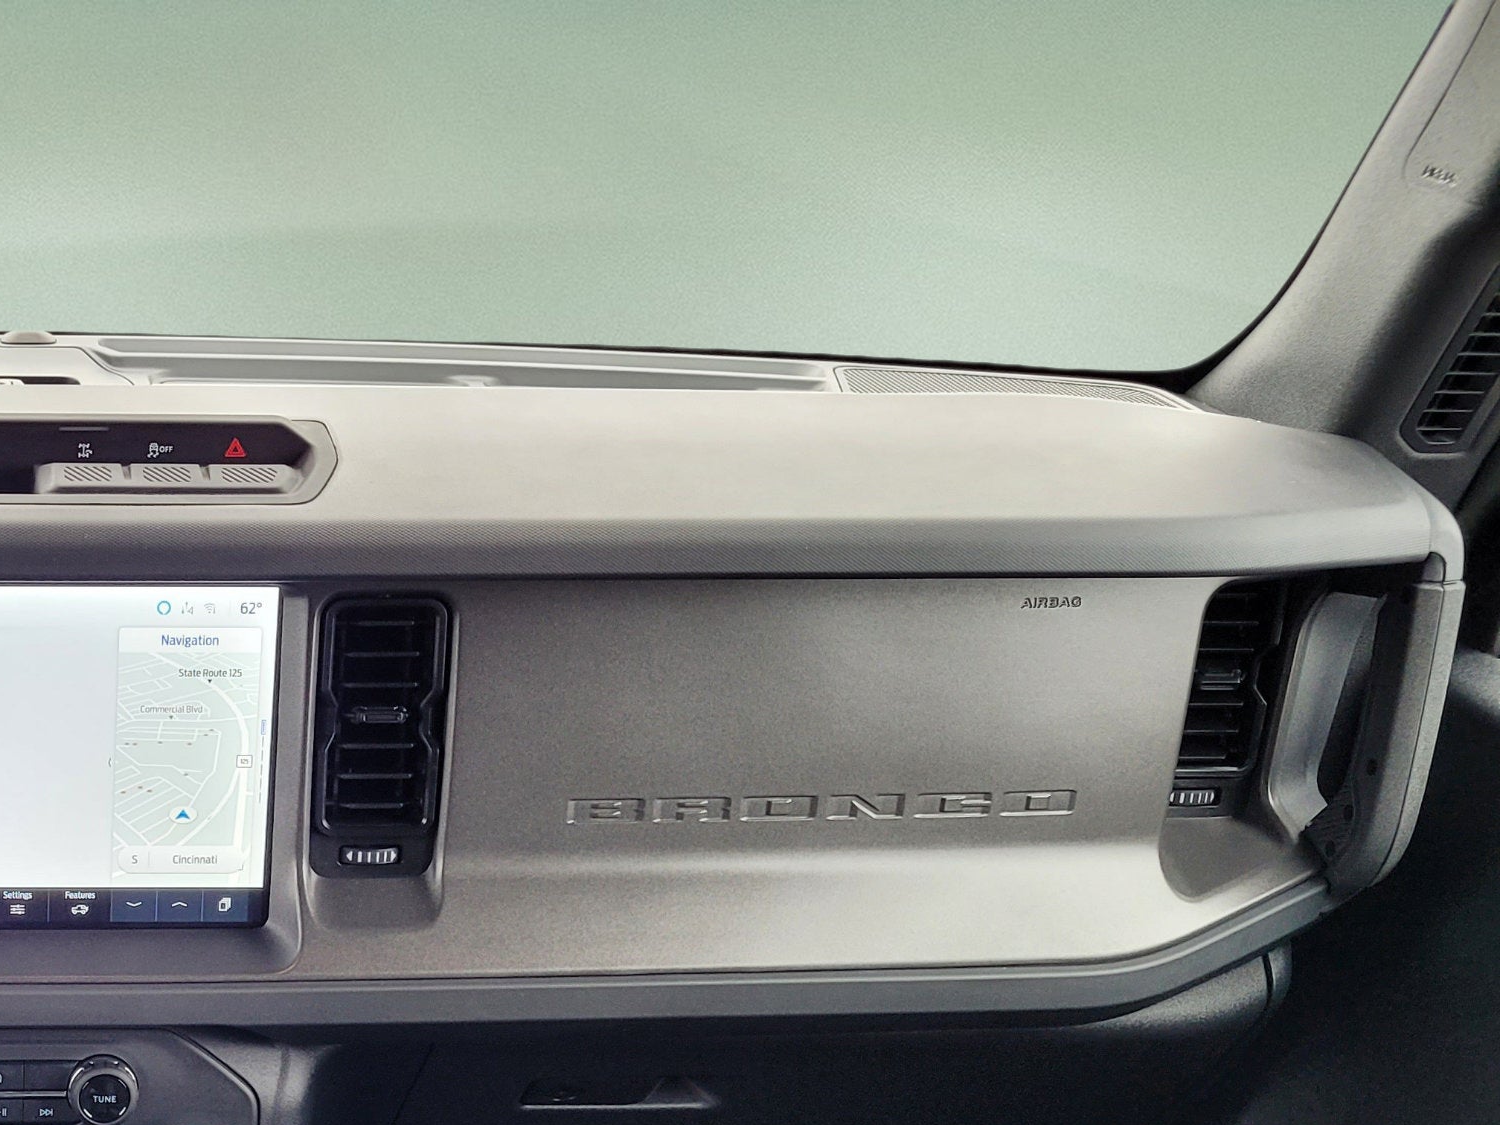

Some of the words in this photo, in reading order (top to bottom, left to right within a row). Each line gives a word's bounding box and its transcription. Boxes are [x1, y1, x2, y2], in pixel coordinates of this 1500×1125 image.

[159, 445, 174, 453] OFF
[1020, 596, 1082, 609] AIRBAG
[240, 602, 263, 614] 62°
[161, 634, 220, 648] Navigation
[178, 668, 202, 678] State
[202, 668, 228, 678] Route
[229, 668, 243, 678] 125
[140, 705, 185, 714] Commercial
[186, 705, 203, 714] Blvd
[566, 788, 1078, 825] BRONCO
[131, 855, 139, 865] S
[172, 854, 218, 865] Cincinnati
[2, 890, 33, 900] Settings
[64, 890, 96, 899] Features
[92, 1095, 117, 1104] TUNE
